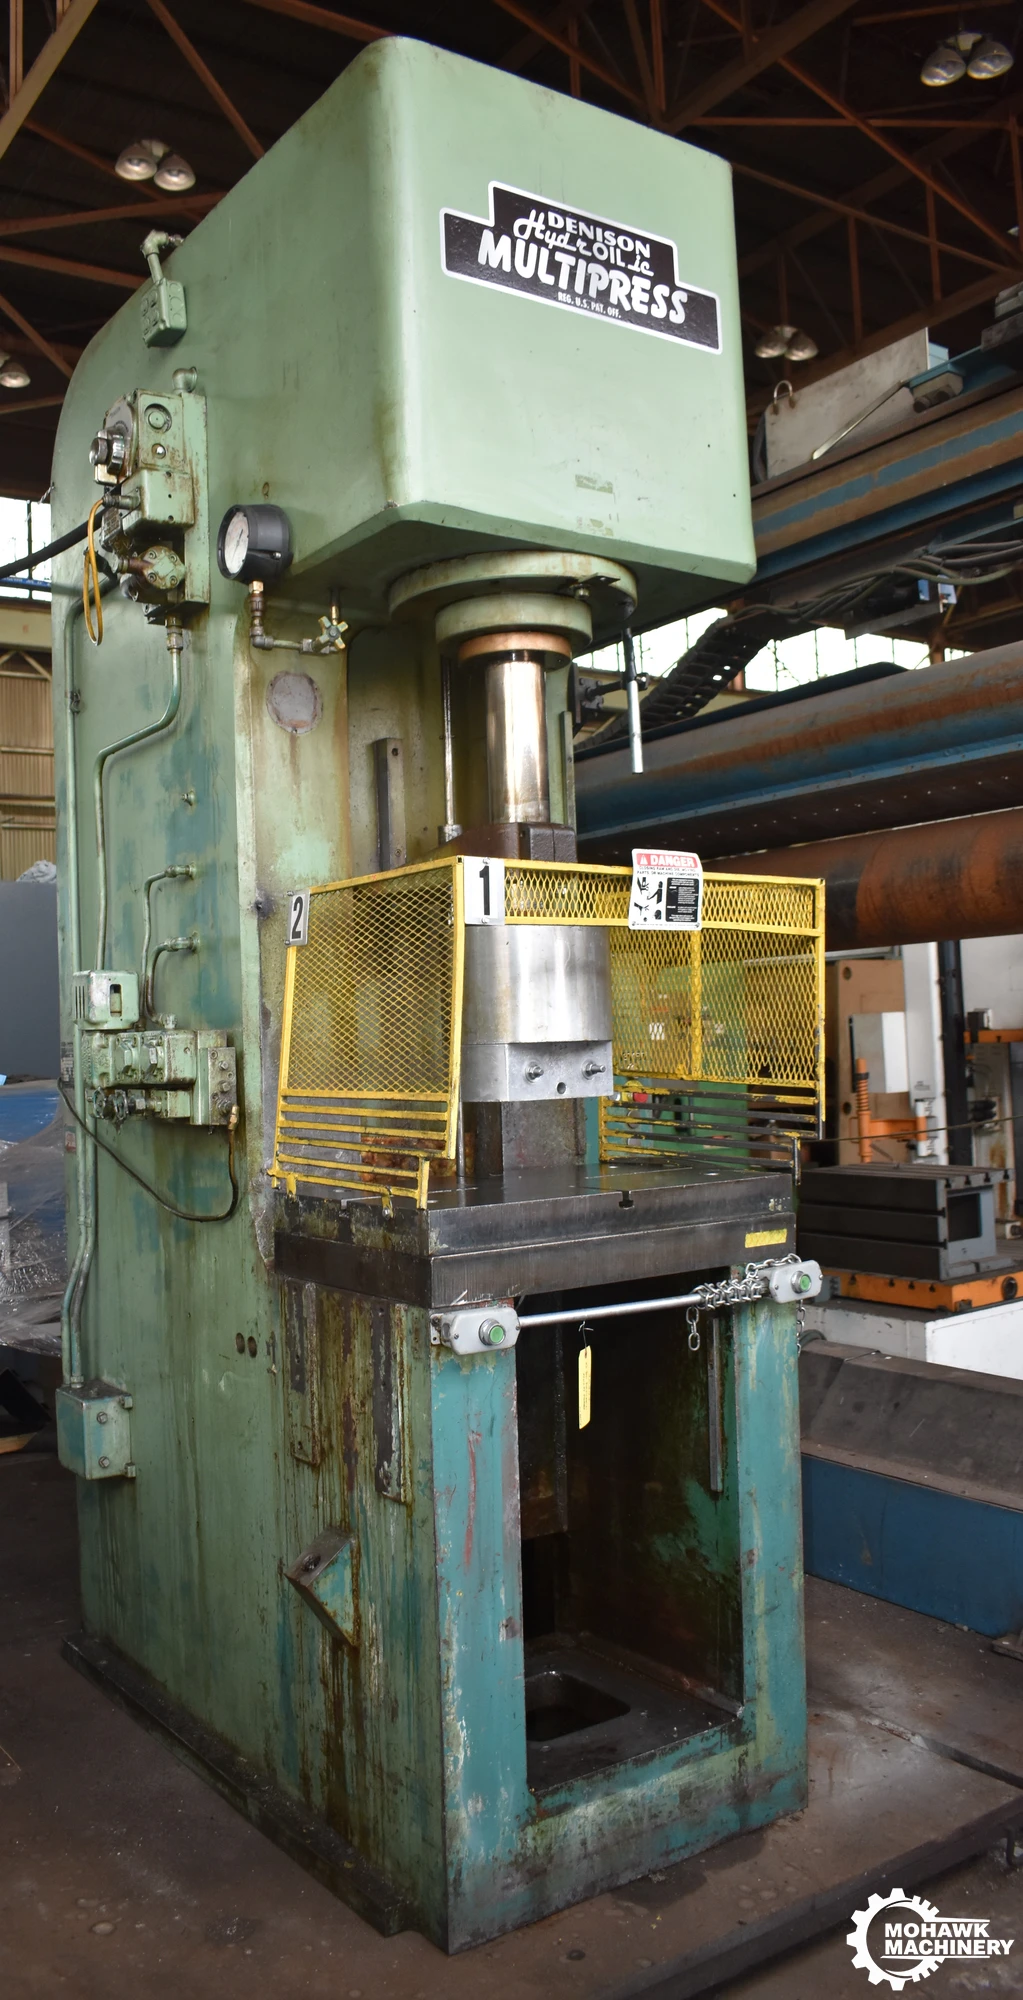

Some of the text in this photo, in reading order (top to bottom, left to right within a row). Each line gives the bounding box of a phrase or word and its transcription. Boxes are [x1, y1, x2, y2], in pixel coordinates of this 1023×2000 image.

[548, 211, 650, 258] DENISON
[477, 228, 688, 325] MULTIPRESS
[557, 291, 622, 319] REG. U.S. PAT. OFF.
[650, 855, 695, 867] DANGER
[479, 865, 491, 916] 1
[291, 896, 303, 939] 2
